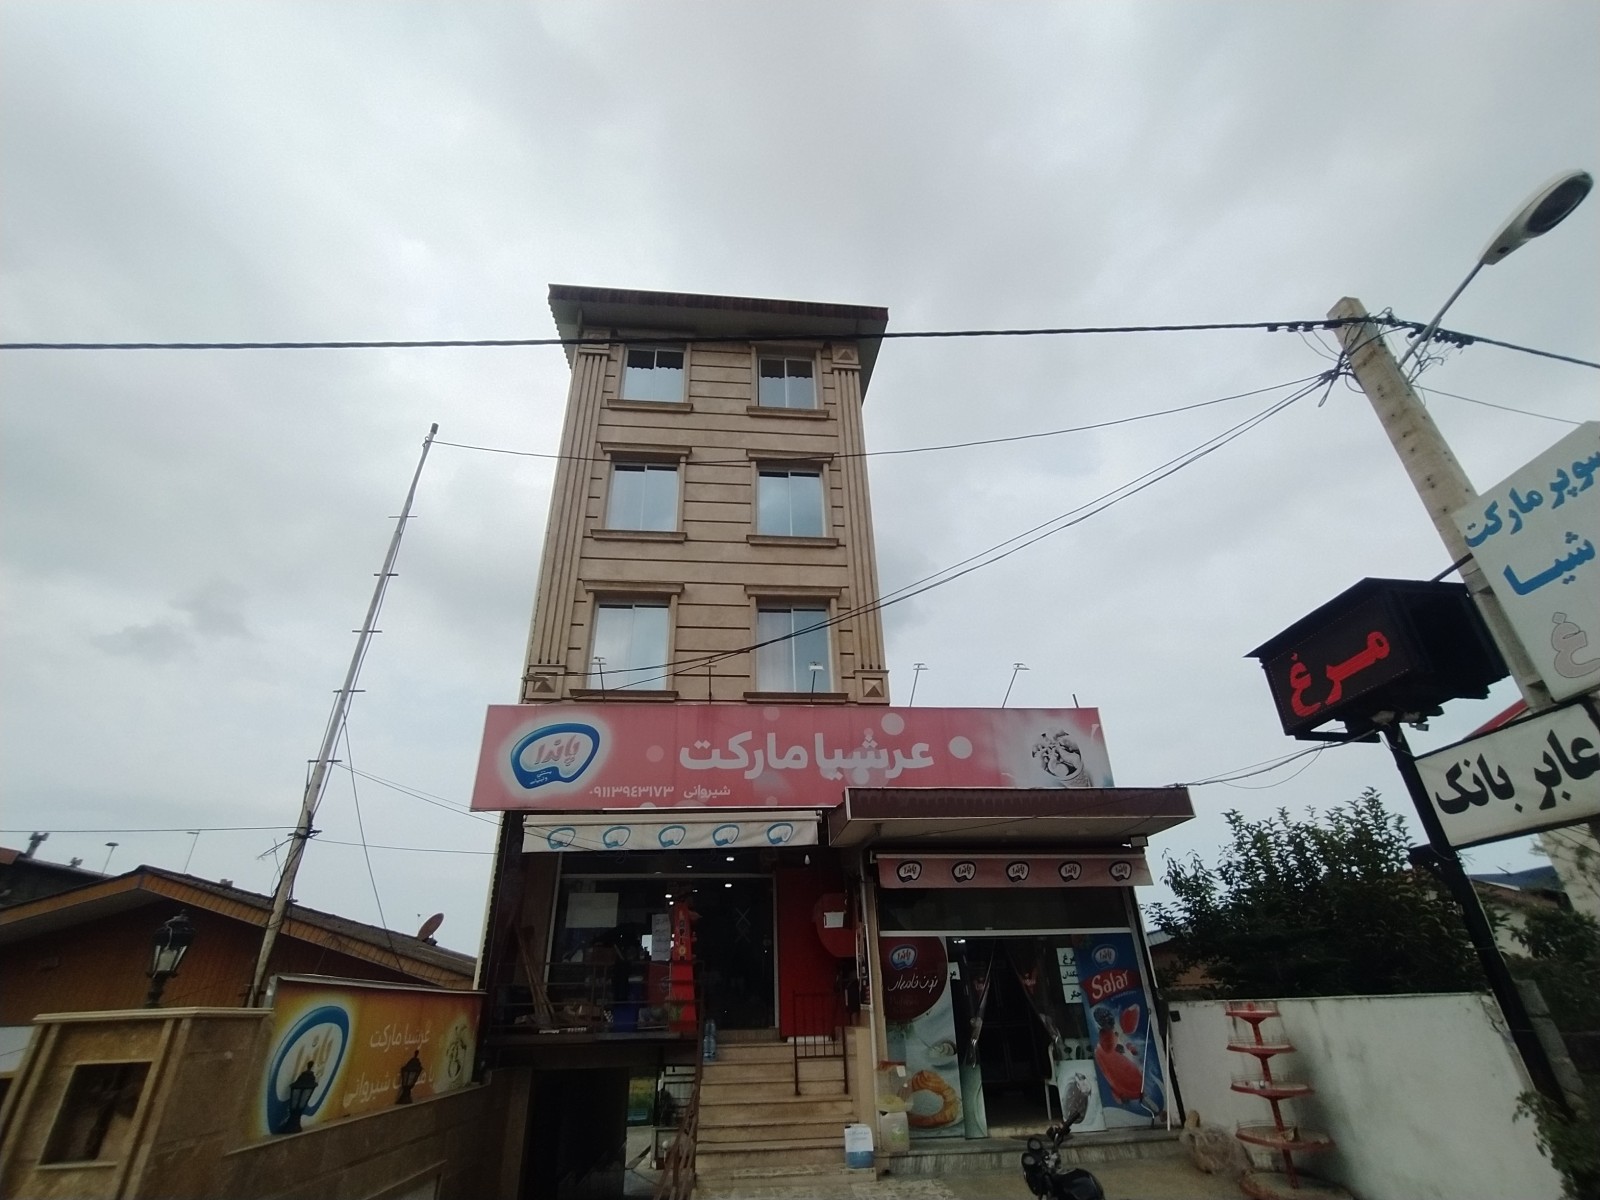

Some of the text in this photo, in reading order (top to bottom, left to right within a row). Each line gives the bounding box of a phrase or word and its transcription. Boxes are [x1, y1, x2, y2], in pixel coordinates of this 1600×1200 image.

[1464, 488, 1544, 547] مارکت
[1503, 531, 1596, 596] شیا
[1290, 631, 1391, 718] مرغ
[535, 735, 580, 766] پاندا
[680, 731, 934, 781] عرشیا مارکت
[1435, 729, 1600, 814] عابر بانک
[683, 785, 731, 799] شیروانی
[1091, 969, 1128, 1000] Salar
[370, 1022, 402, 1053] مارکت
[342, 1071, 391, 1109] شیروانی
